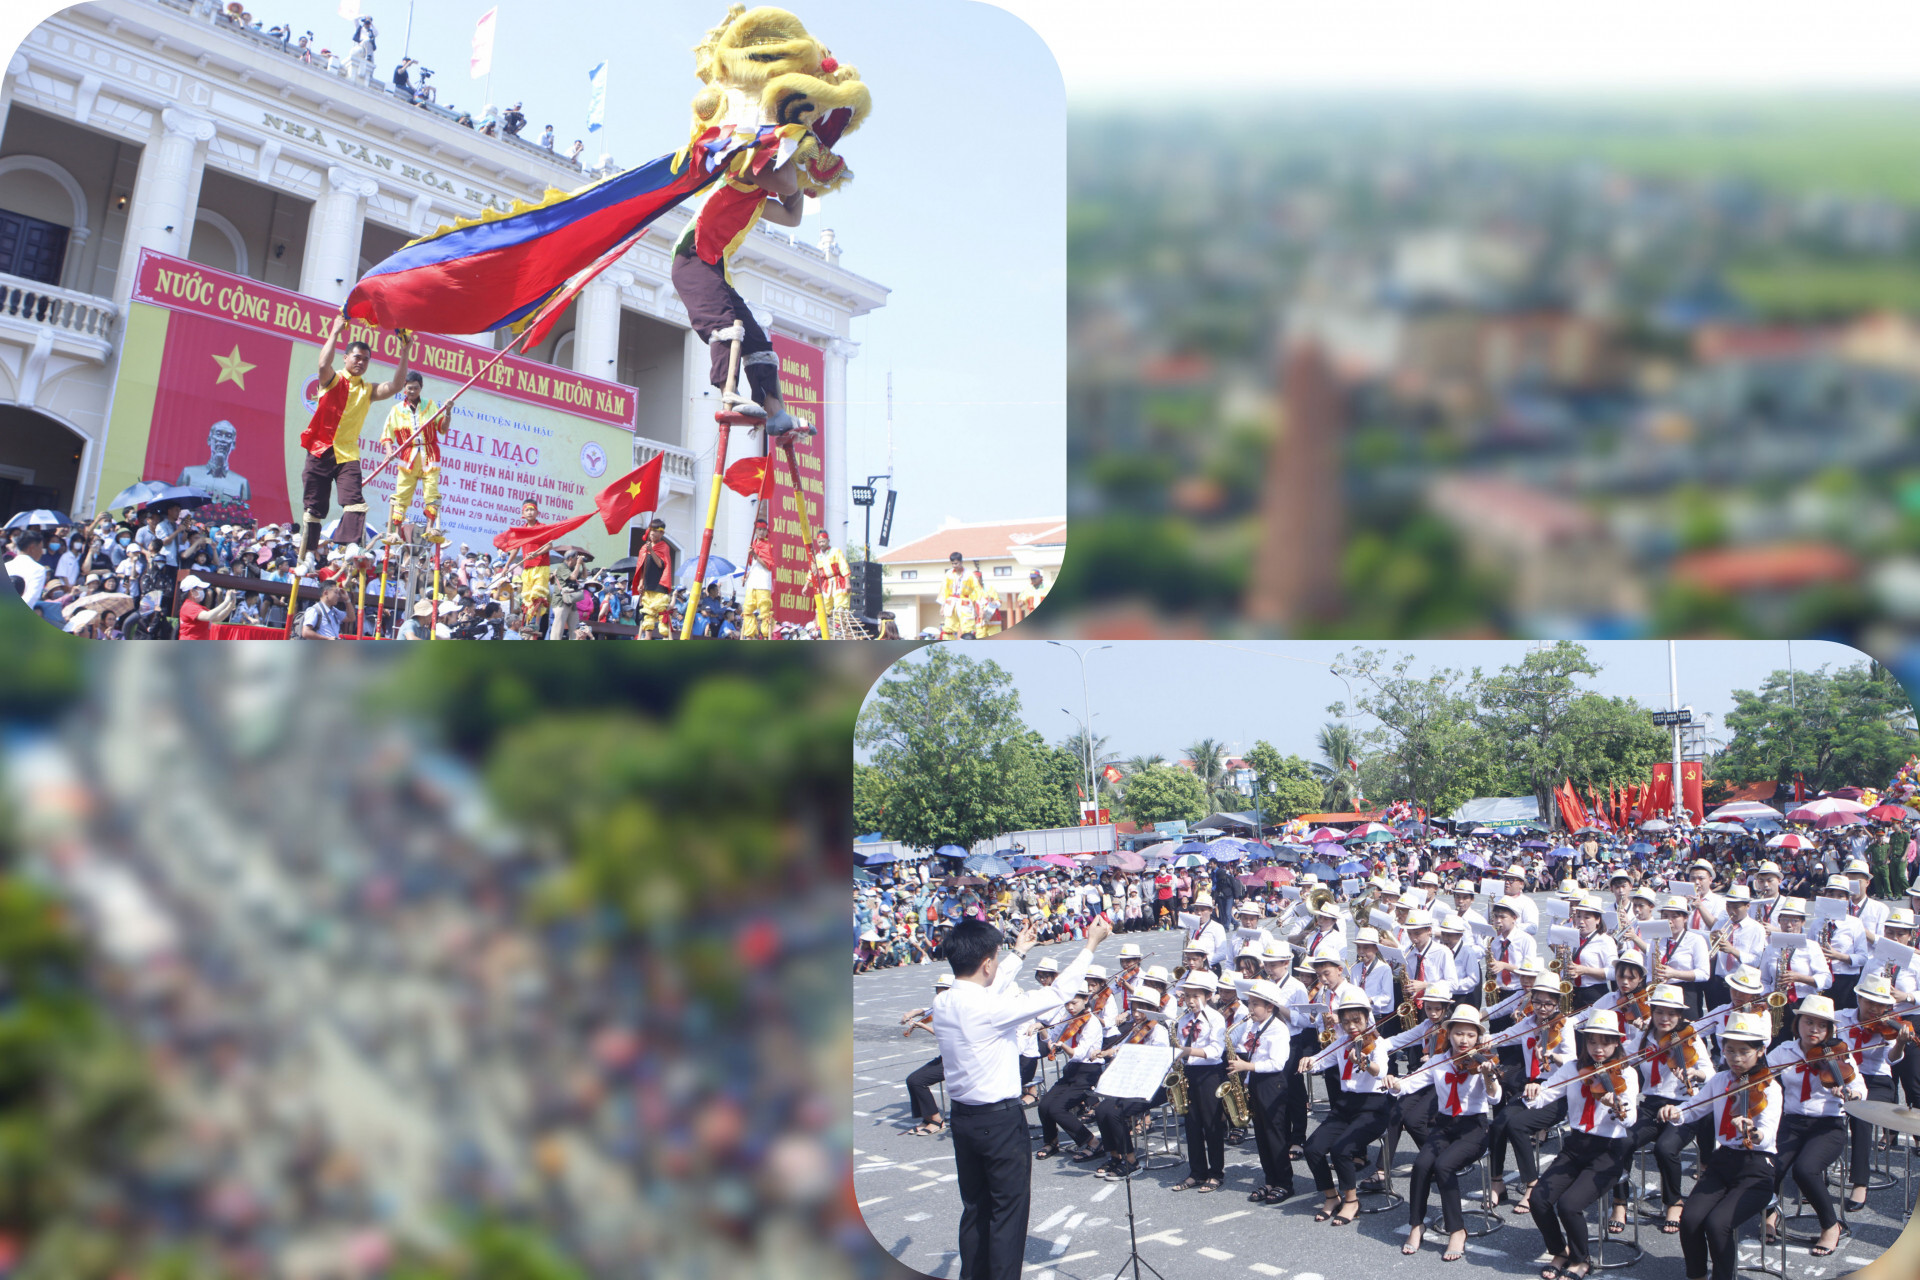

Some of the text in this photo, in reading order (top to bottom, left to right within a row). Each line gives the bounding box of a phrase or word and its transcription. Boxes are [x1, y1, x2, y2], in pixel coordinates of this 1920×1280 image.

[263, 113, 328, 148] NHÀ
[336, 139, 394, 171] VĂN
[400, 163, 456, 195] HÓA
[154, 268, 215, 306] NƯỚC
[218, 285, 270, 320] CỘNG
[273, 301, 313, 335] HÒA
[316, 314, 344, 344] X
[422, 343, 474, 378] NGHĨA
[478, 357, 515, 390] VIỆT
[516, 369, 550, 397] NAM
[553, 380, 593, 408] MUÔN
[596, 389, 626, 417] NĂM
[780, 379, 795, 398] UÂN
[794, 383, 804, 400] VÀ
[394, 392, 555, 438] BA DÂN HUYỆN HẢI HẬU
[436, 428, 540, 467] HAI MẠC
[360, 457, 383, 473] GÀY
[385, 462, 399, 479] HỘ
[480, 481, 505, 498] THAO
[545, 494, 574, 511] THỐNG
[463, 460, 496, 478] HUYỆN
[498, 465, 515, 483] HẢI
[517, 471, 536, 488] HẬU
[576, 484, 585, 496] IX
[440, 504, 466, 517] HÁNH
[468, 509, 483, 520] 2/9
[485, 511, 508, 524] NĂM
[510, 518, 527, 527] 202
[449, 493, 469, 505] NĂM
[471, 497, 495, 510] CÁCH
